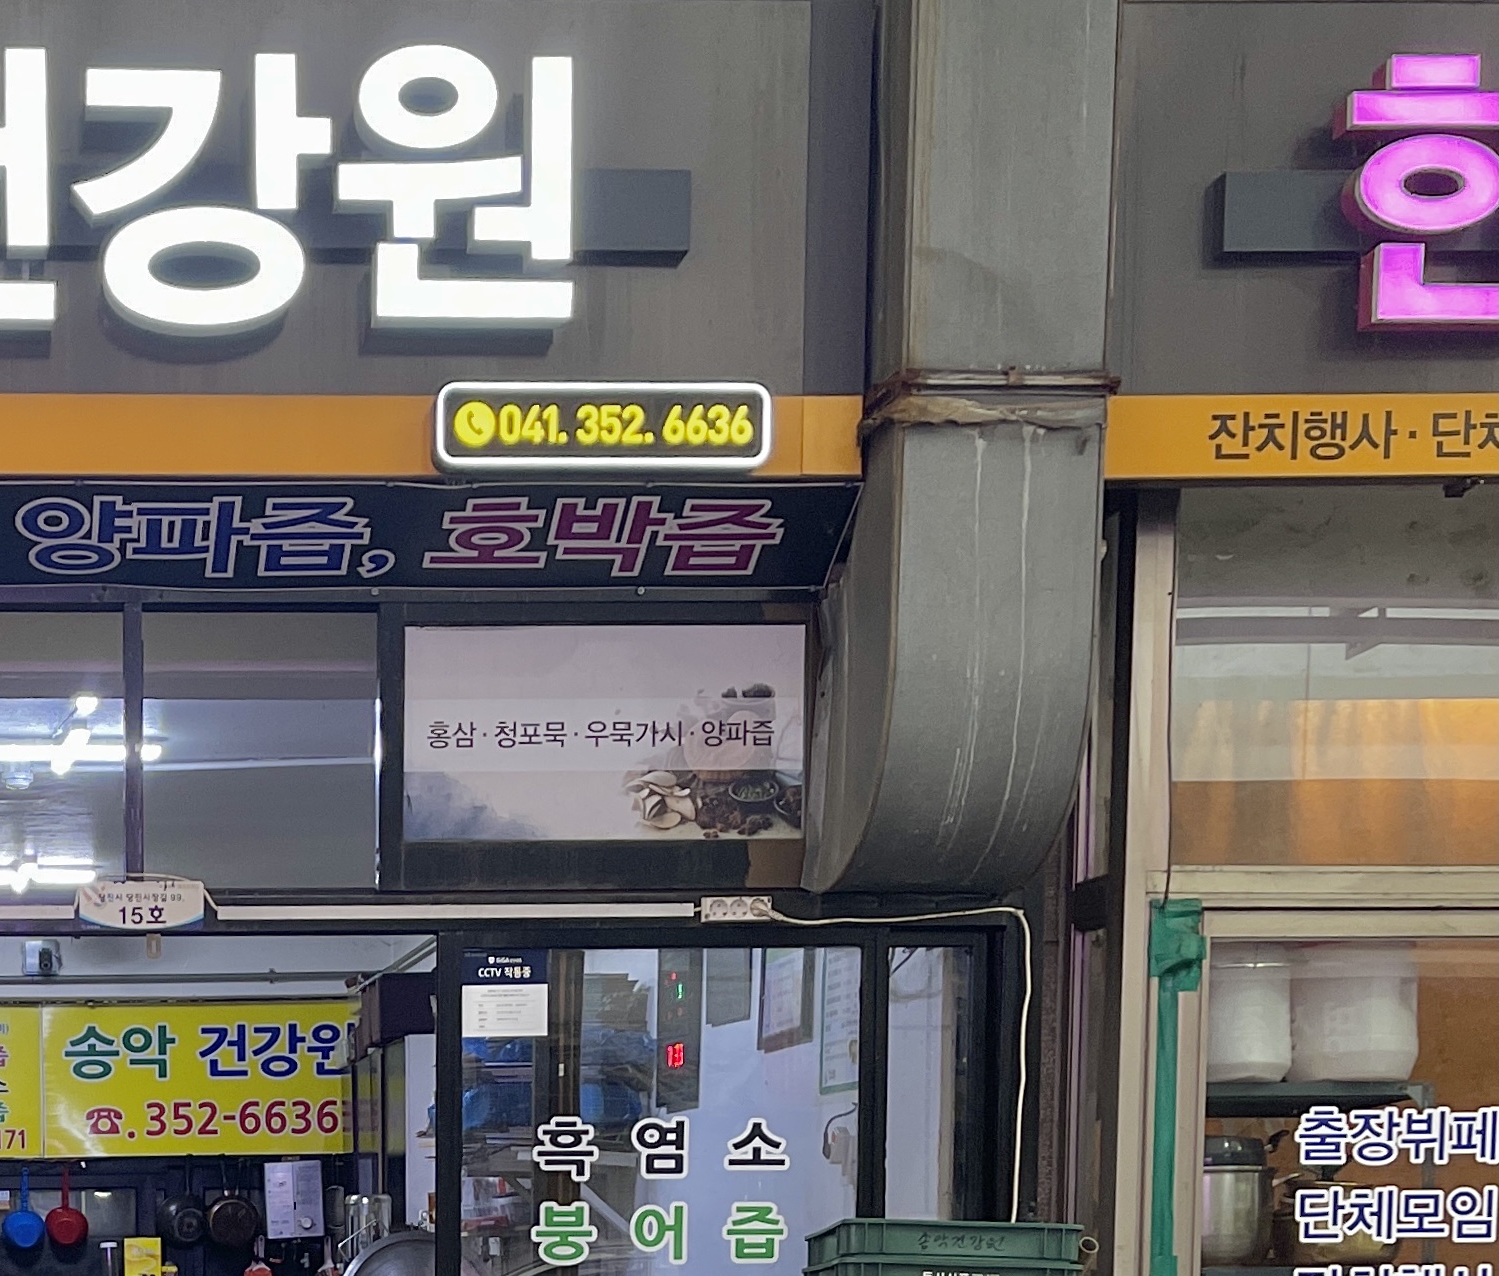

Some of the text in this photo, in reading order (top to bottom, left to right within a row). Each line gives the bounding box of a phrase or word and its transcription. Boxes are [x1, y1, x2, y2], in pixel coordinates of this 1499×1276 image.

[498, 404, 754, 447] 041. 352. 6636
[1208, 409, 1399, 461] 잔치행사
[15, 493, 395, 580] 양파즙,
[422, 496, 784, 578] 호박즙
[427, 719, 775, 748] 홍삼 청포묵 우묵가시 양파즙
[119, 905, 167, 925] 15호
[478, 967, 502, 977] CCTV
[64, 1025, 176, 1079] 송악
[1295, 1107, 1499, 1165] 출장뷔페
[1295, 1186, 1497, 1242] 단체모임
